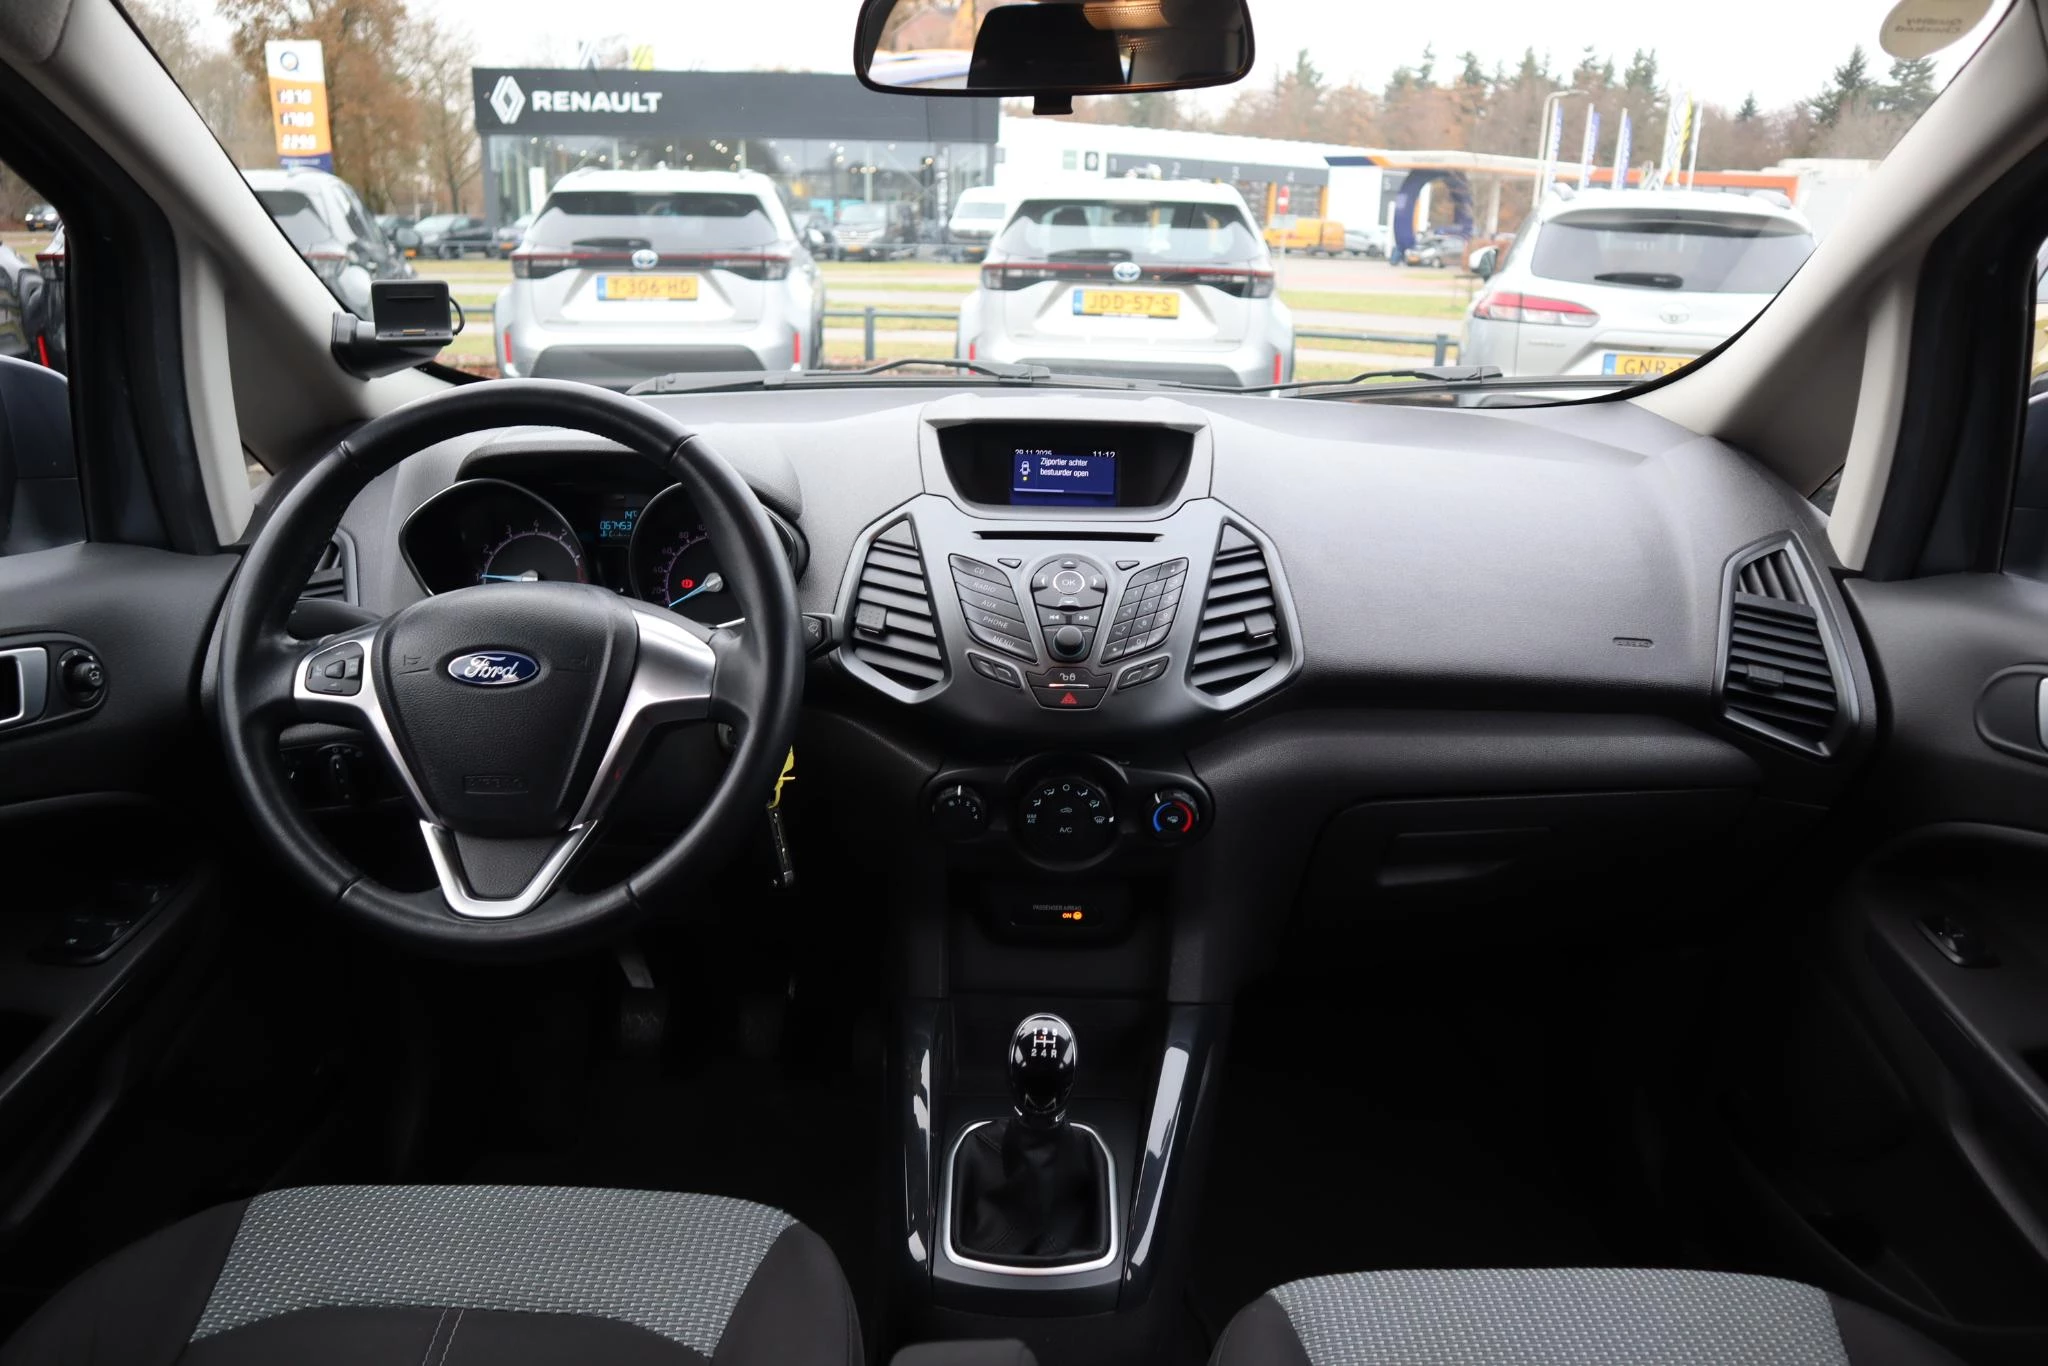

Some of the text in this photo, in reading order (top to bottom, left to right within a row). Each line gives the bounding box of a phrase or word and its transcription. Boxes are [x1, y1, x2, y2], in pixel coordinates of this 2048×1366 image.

[531, 90, 663, 113] RENAULT
[1088, 294, 1172, 312] JDD-57-S
[1068, 459, 1088, 467] achter
[1040, 468, 1089, 479] bestuurder open
[974, 566, 985, 575] CD
[973, 582, 997, 593] RADIO
[981, 599, 997, 609] AUX
[982, 615, 1009, 629] PHONE
[992, 635, 1015, 649] MENU
[464, 655, 520, 679] Ford
[1061, 911, 1073, 920] ON
[1033, 1027, 1038, 1035] 1
[1042, 1027, 1048, 1035] 3
[1031, 1048, 1057, 1058] 2 4 R
